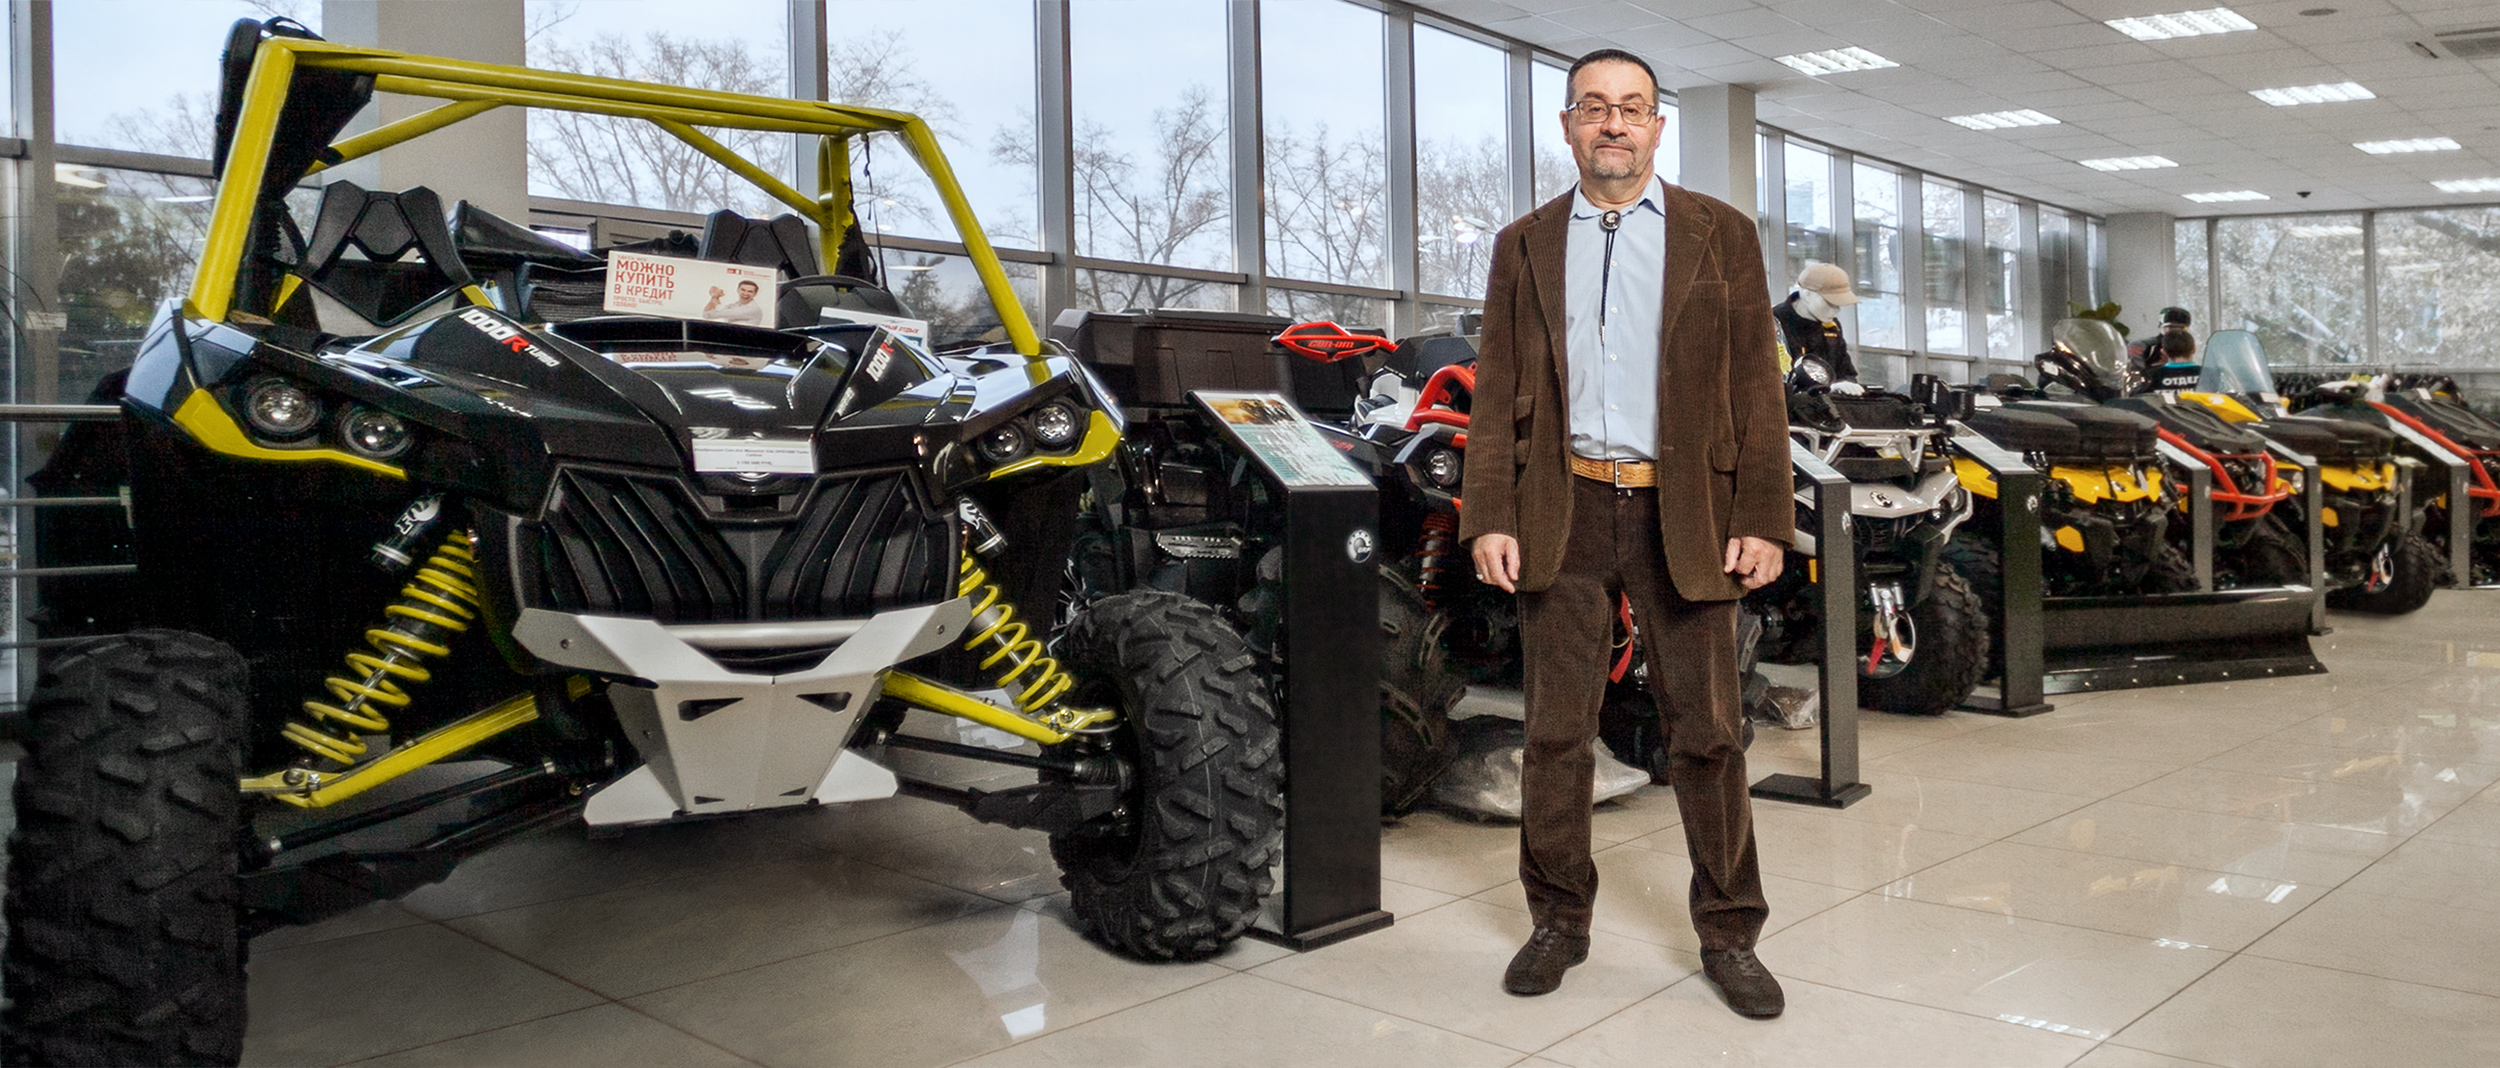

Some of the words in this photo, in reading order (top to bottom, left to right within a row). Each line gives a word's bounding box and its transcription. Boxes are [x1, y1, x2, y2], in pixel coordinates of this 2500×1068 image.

[616, 260, 674, 276] МОЖНО
[615, 271, 674, 288] КУПИТЬ
[614, 283, 622, 294] В
[626, 285, 674, 300] КРЕДИТ
[458, 309, 530, 353] 1000R
[524, 344, 561, 368] TURBO
